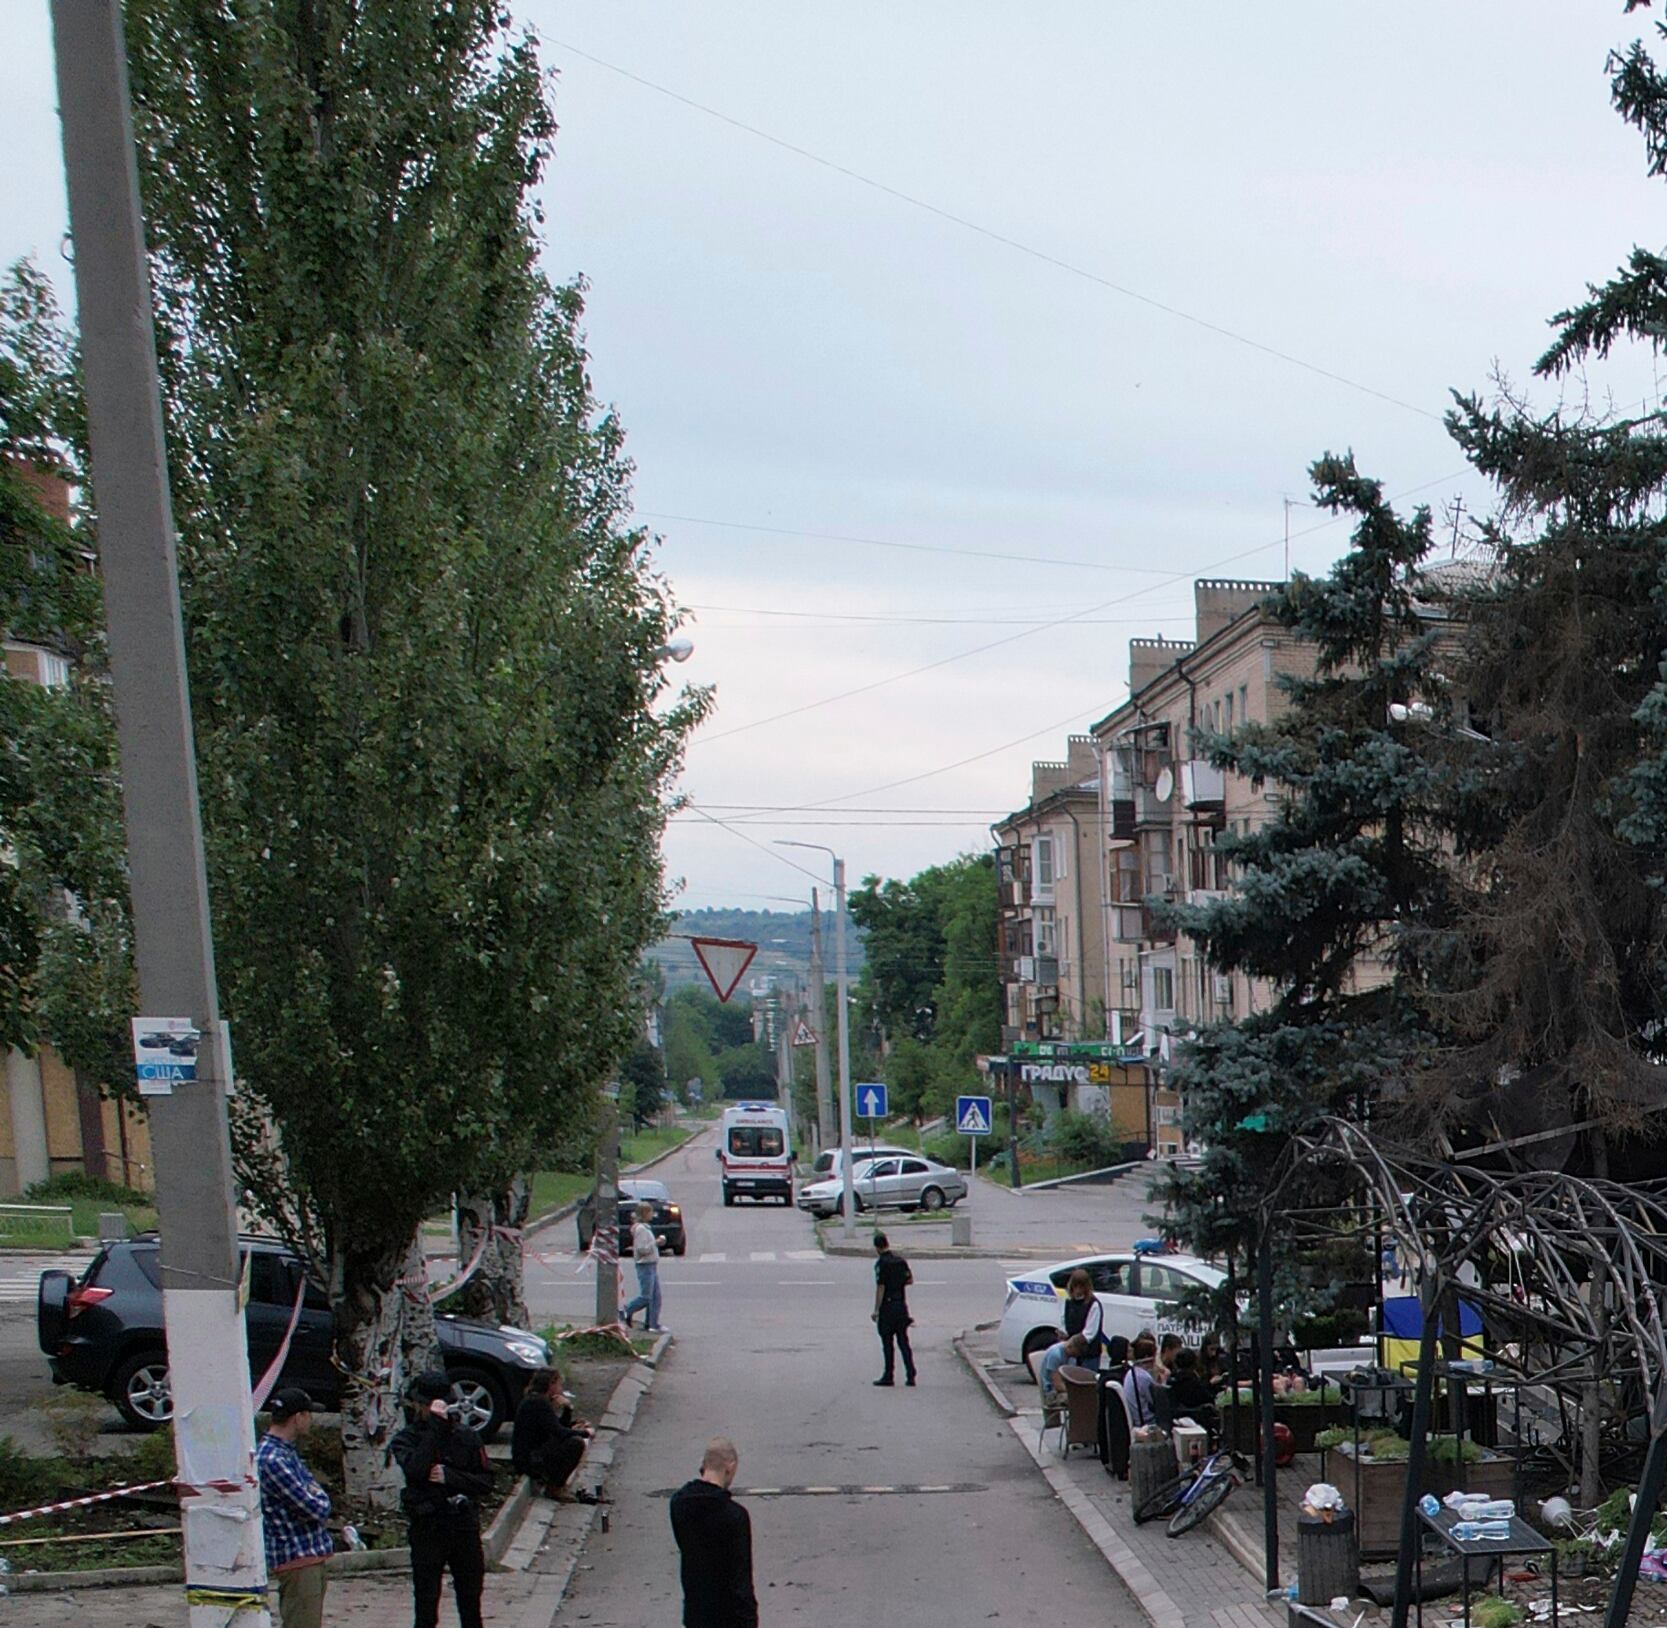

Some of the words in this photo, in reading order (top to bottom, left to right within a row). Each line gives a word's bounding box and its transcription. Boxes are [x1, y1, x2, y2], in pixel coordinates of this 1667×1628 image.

[142, 1065, 184, 1080] США
[1021, 1064, 1089, 1081] ГРАДУС
[1089, 1063, 1109, 1081] 24
